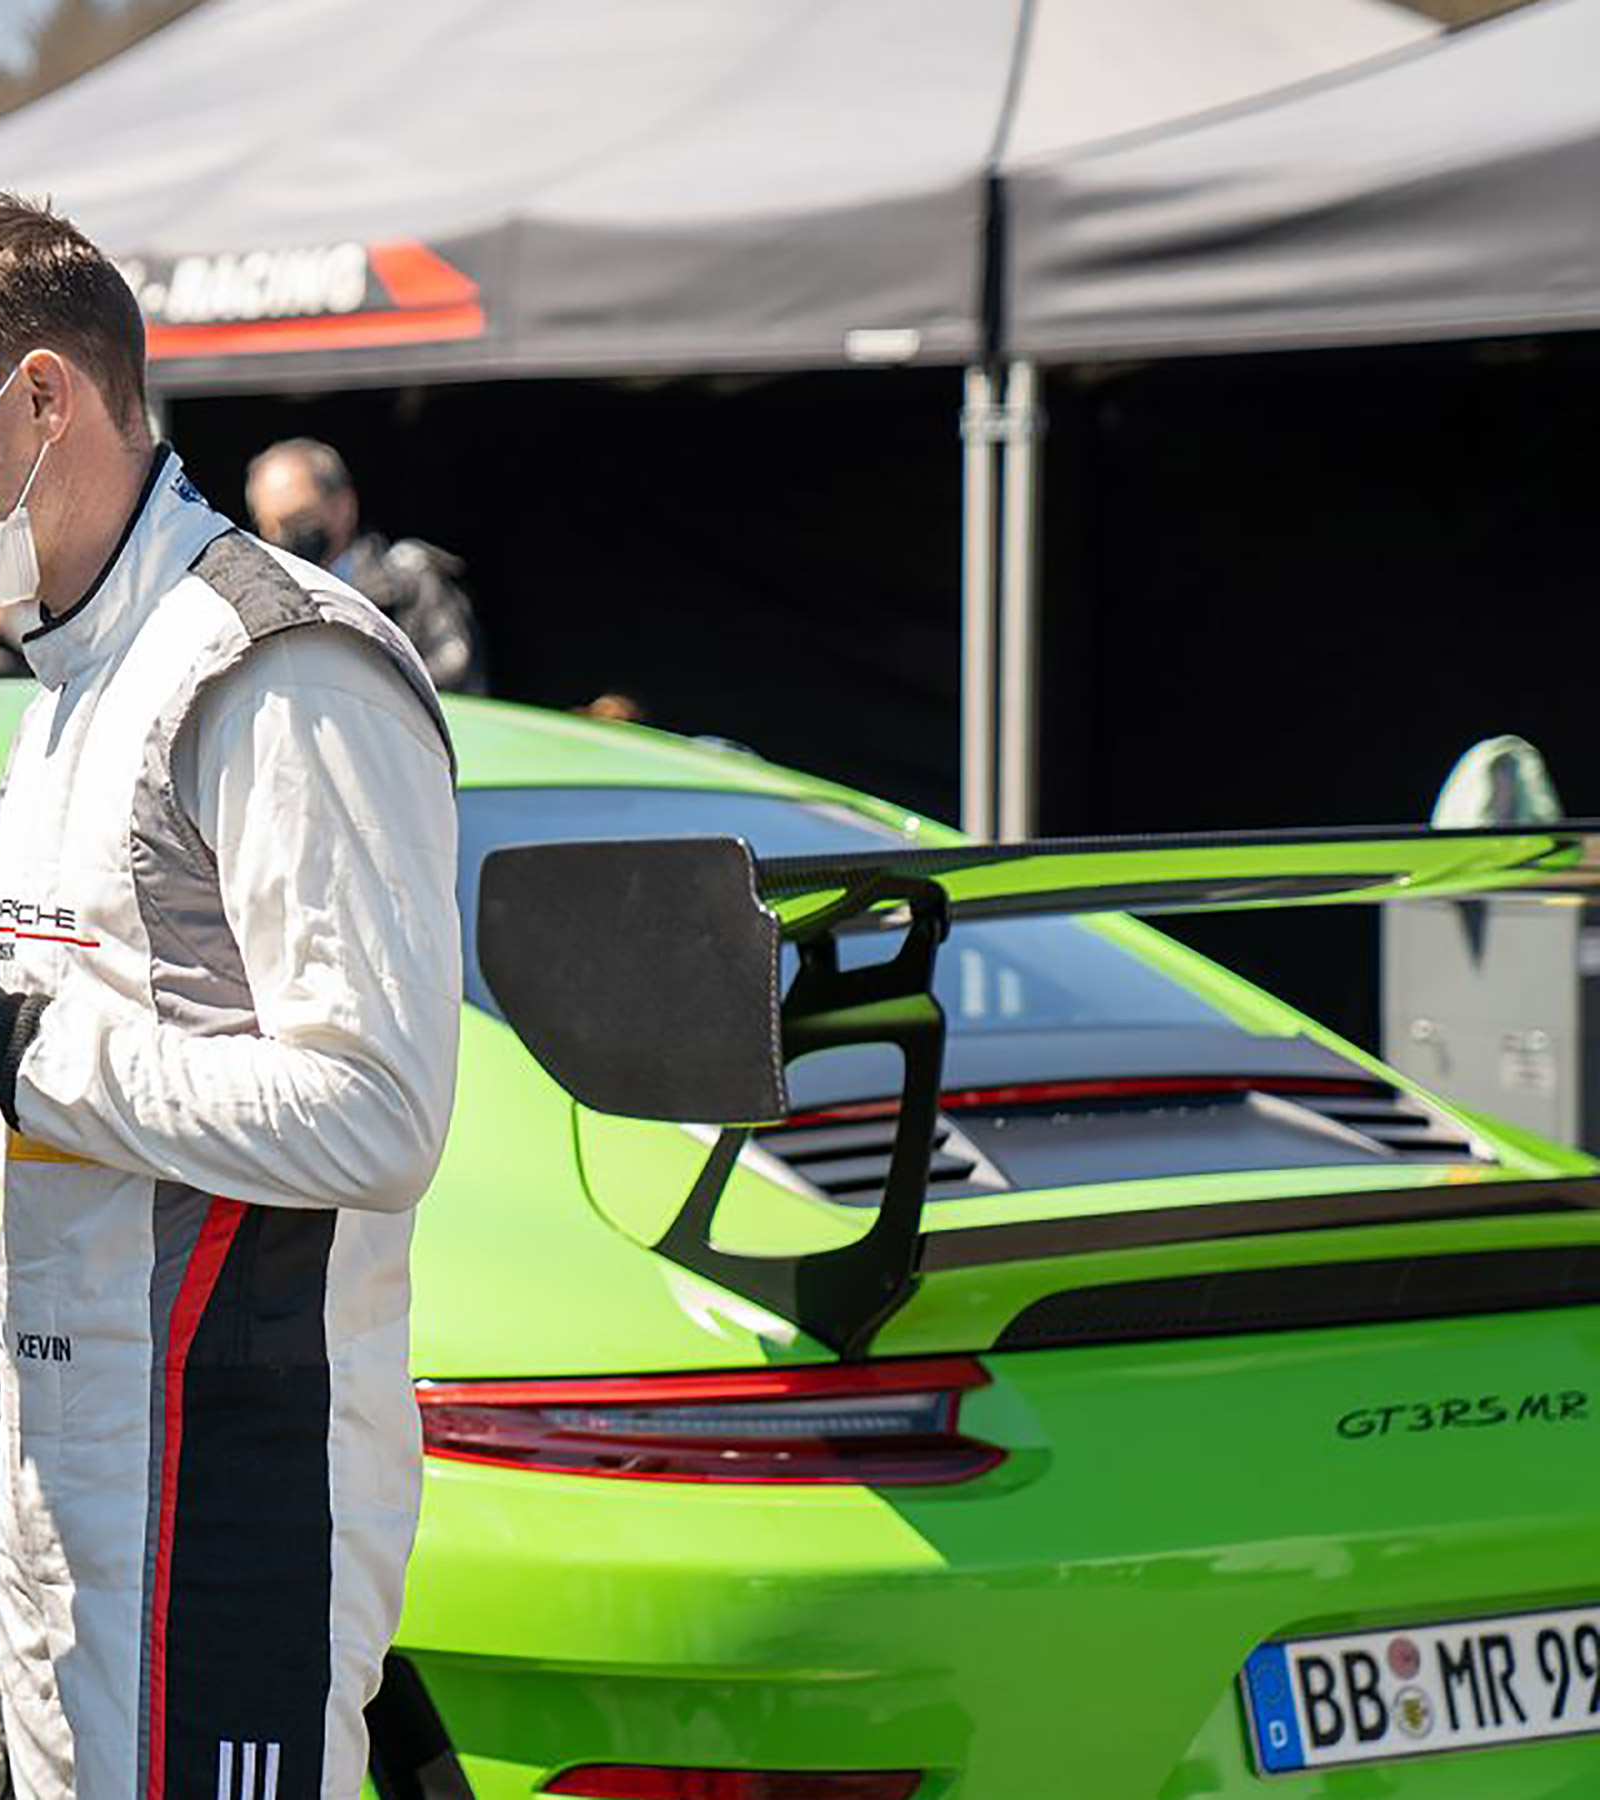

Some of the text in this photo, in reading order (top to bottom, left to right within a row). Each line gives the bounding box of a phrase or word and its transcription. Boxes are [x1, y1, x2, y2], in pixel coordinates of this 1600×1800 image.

[16, 1331, 71, 1362] KEVIN
[1515, 1390, 1590, 1423] MR
[1295, 1650, 1389, 1748] BB
[1435, 1635, 1528, 1731] MR
